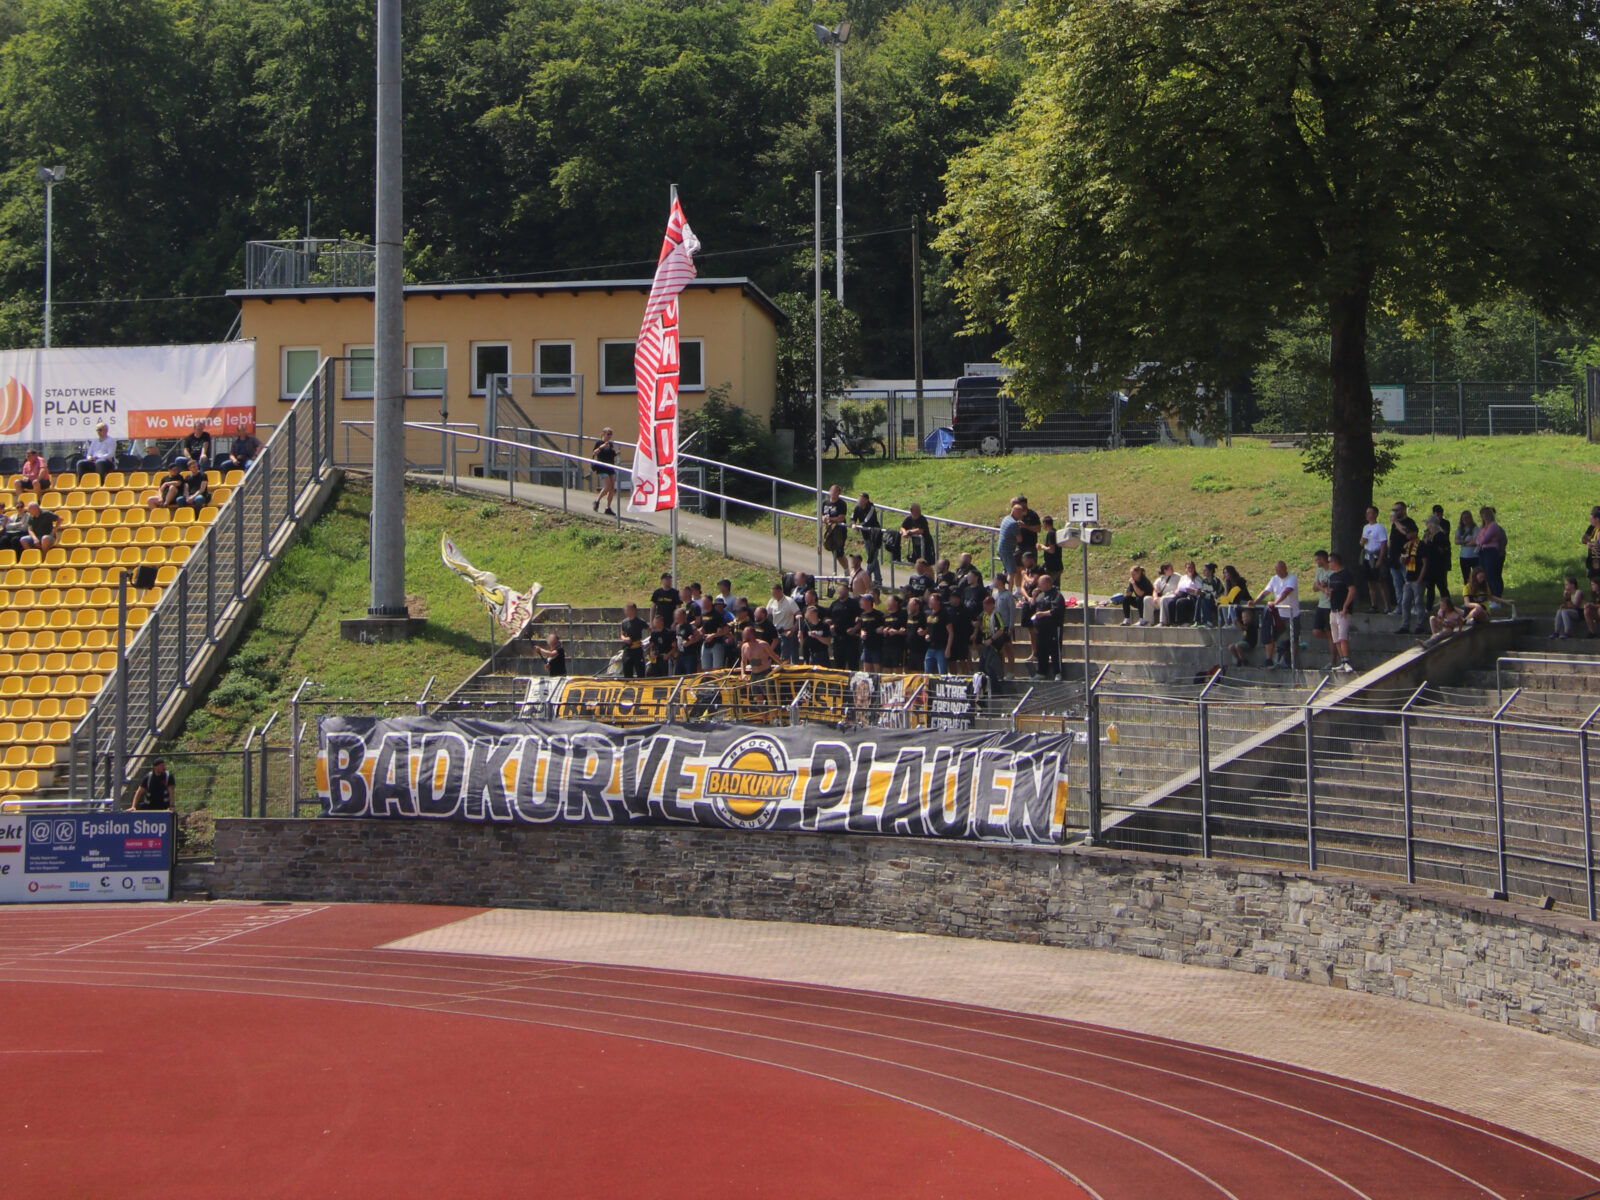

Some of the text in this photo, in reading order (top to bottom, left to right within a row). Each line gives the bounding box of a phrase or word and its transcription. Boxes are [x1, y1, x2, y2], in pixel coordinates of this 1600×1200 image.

[44, 387, 116, 398] STADTWERKE
[44, 399, 116, 415] PLAUEN
[44, 416, 117, 427] ERDGAS
[146, 415, 168, 428] Wo
[226, 411, 256, 426] lebt.
[1072, 502, 1094, 517] F E
[729, 740, 774, 761] BLOCK
[325, 731, 1062, 843] BADKURVE PLAUEN
[709, 772, 793, 796] BADKURVE
[721, 807, 771, 828] PLAUEN
[81, 820, 167, 838] Epsilon Shop
[69, 880, 90, 889] Blau
